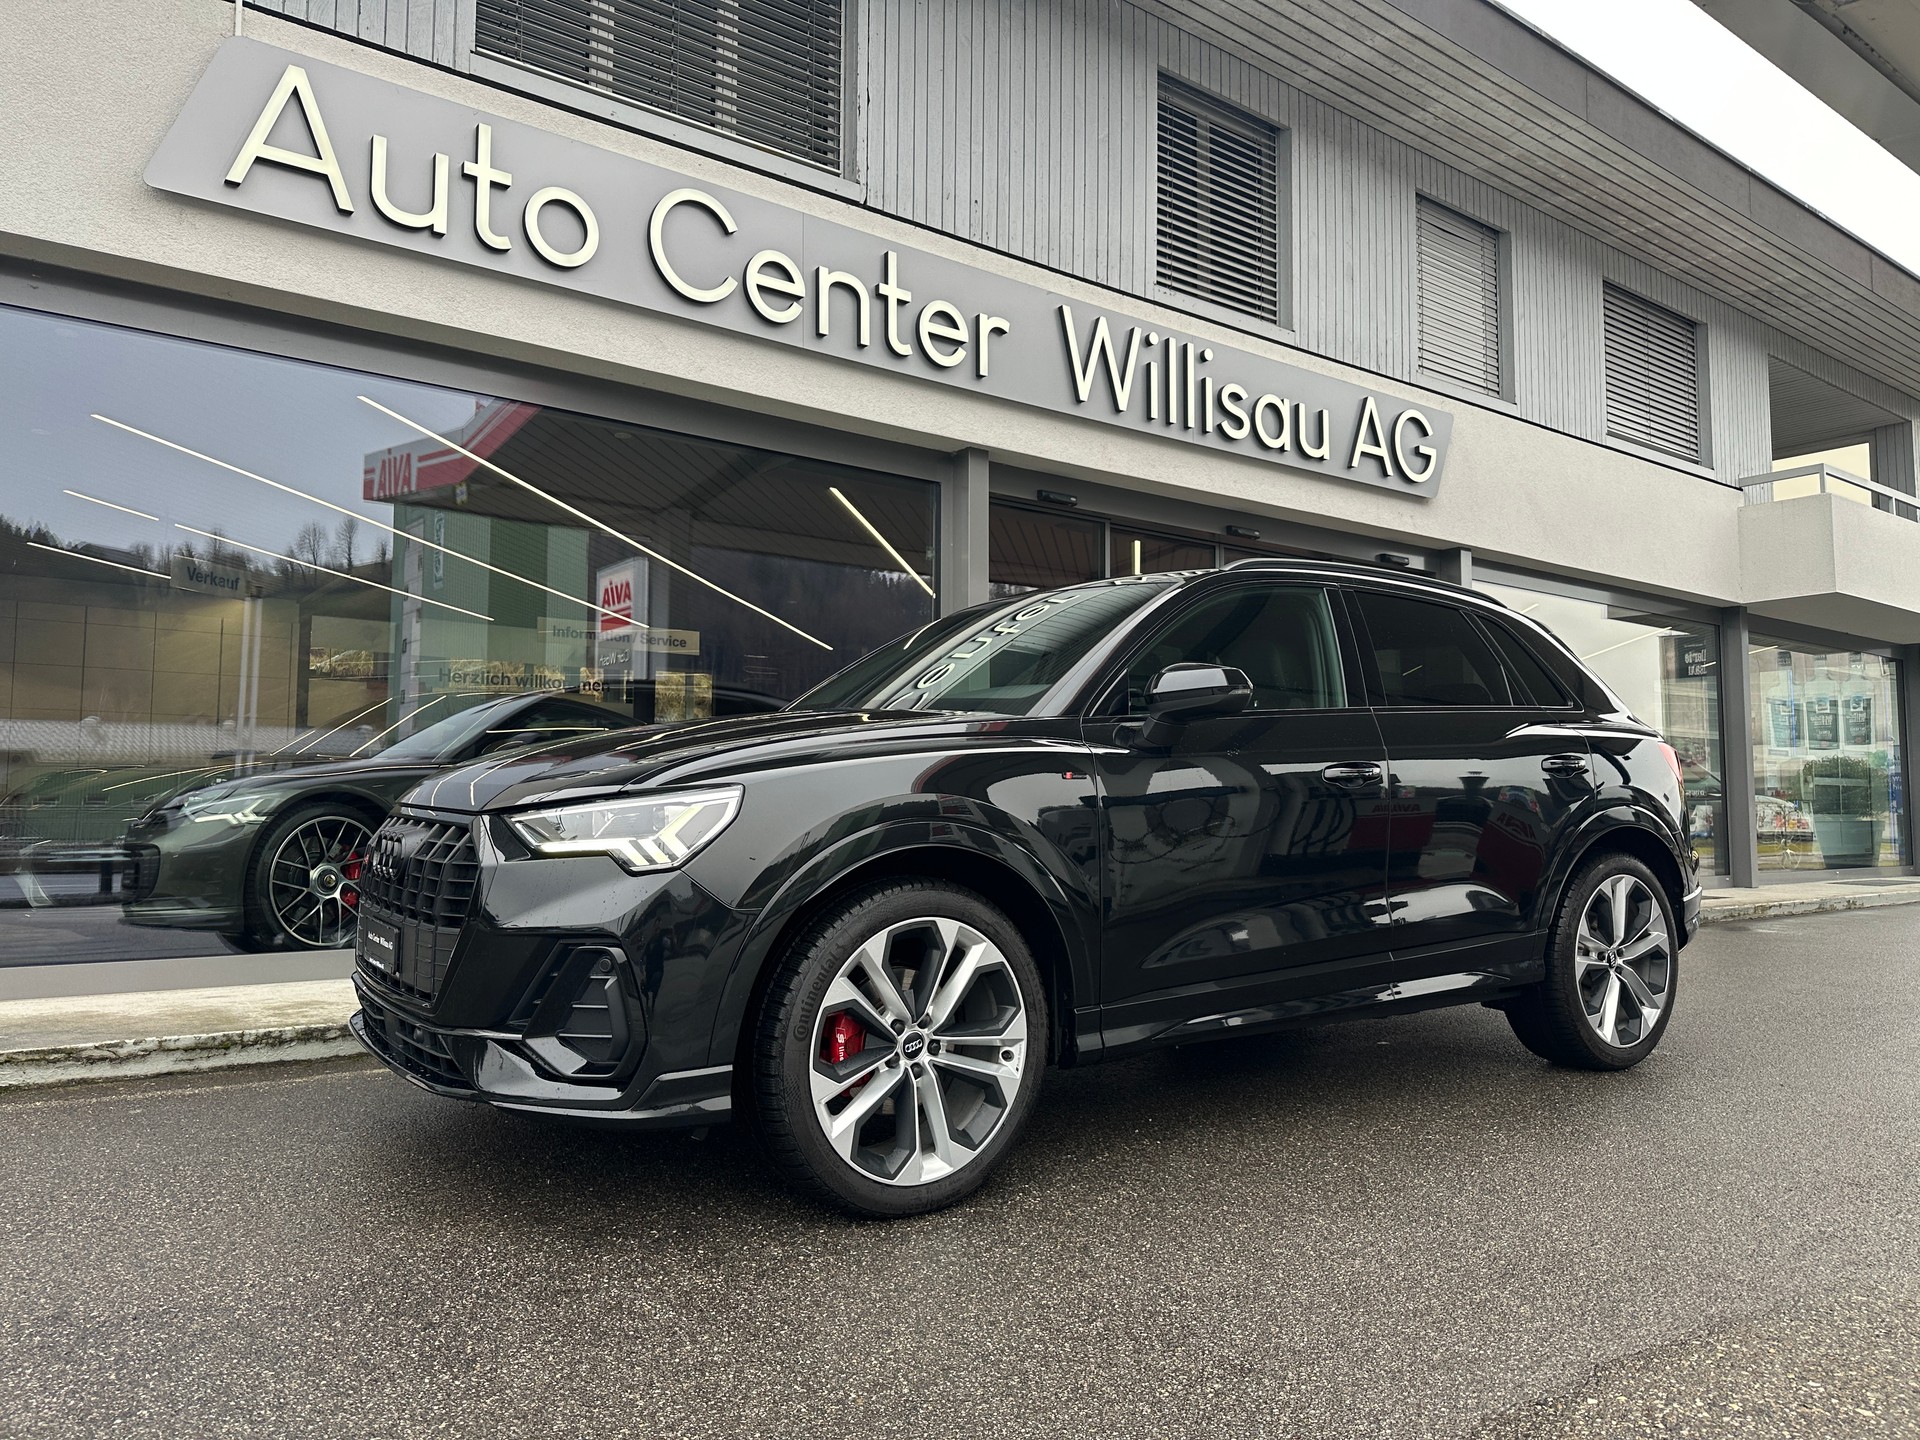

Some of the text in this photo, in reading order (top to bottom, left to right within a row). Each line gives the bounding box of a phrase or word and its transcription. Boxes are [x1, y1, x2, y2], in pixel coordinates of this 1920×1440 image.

[224, 64, 1438, 484] Auto Center Willisau AG
[186, 566, 241, 591] Verkauf
[640, 633, 687, 648] Service
[439, 667, 511, 686] Herzlich
[793, 951, 841, 1041] Continental
